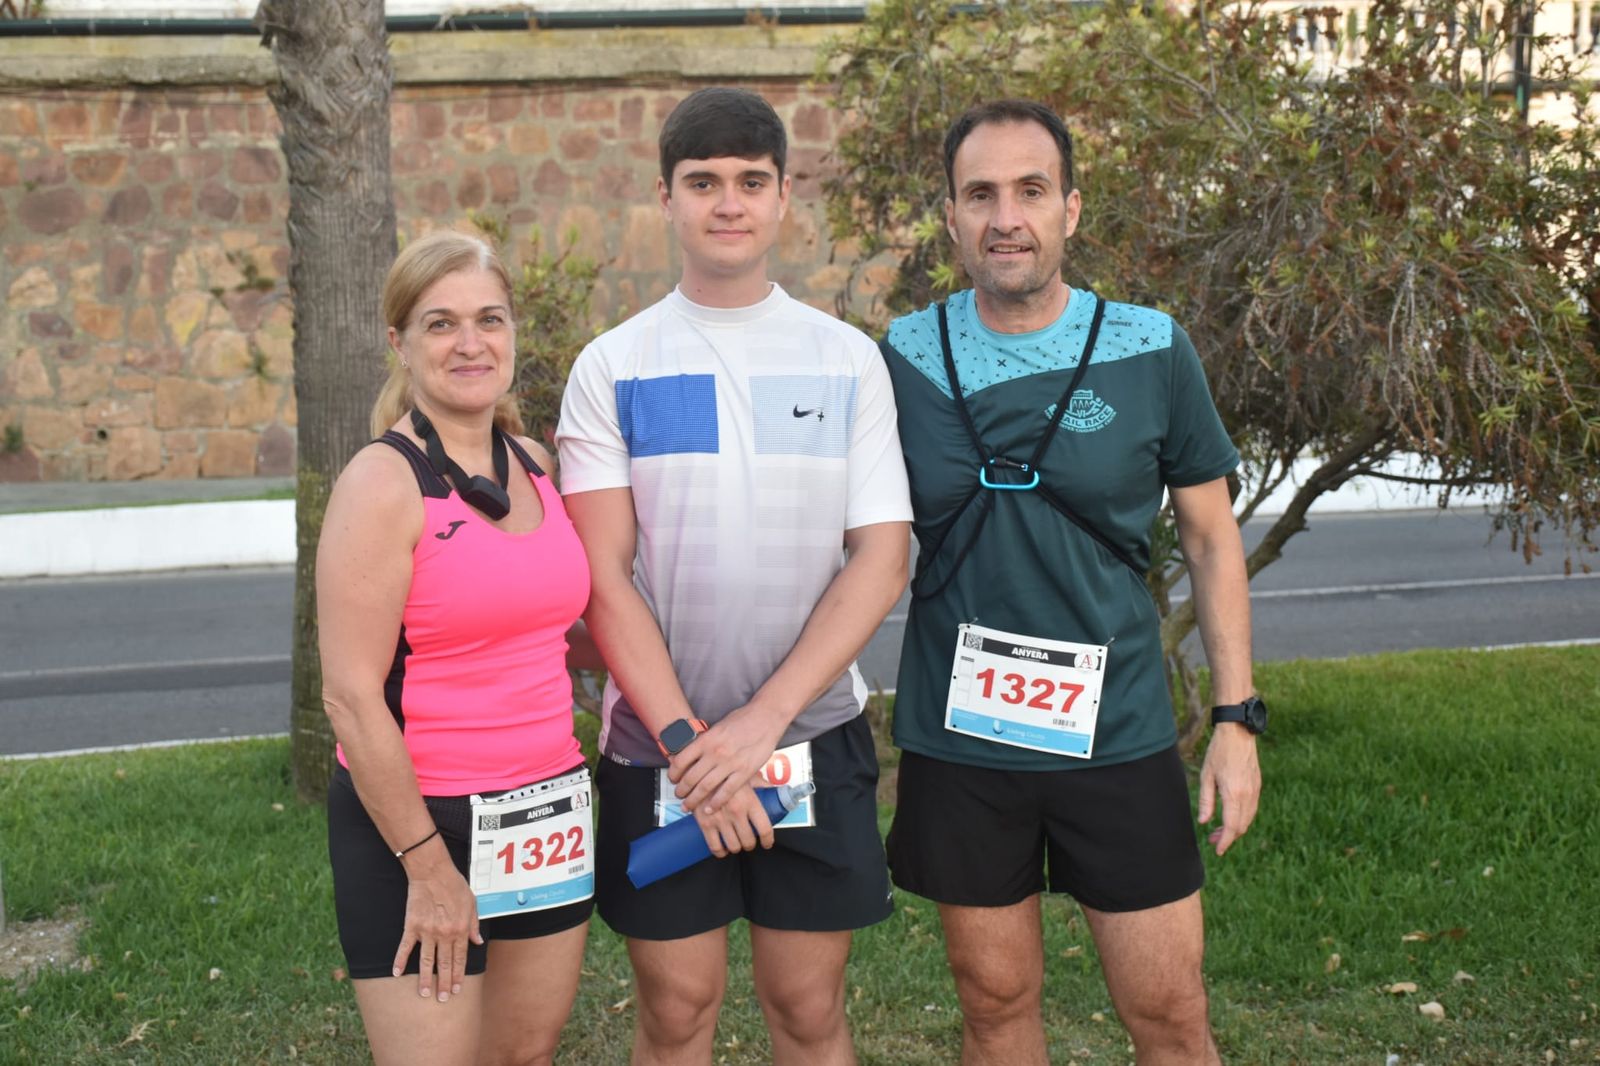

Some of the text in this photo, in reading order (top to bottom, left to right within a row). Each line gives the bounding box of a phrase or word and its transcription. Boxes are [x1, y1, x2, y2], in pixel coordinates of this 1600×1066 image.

[1084, 407, 1111, 427] RACE
[1011, 647, 1049, 661] ANYERA
[976, 668, 1085, 713] 1327
[527, 805, 555, 820] ANYERA
[497, 826, 585, 874] 1322
